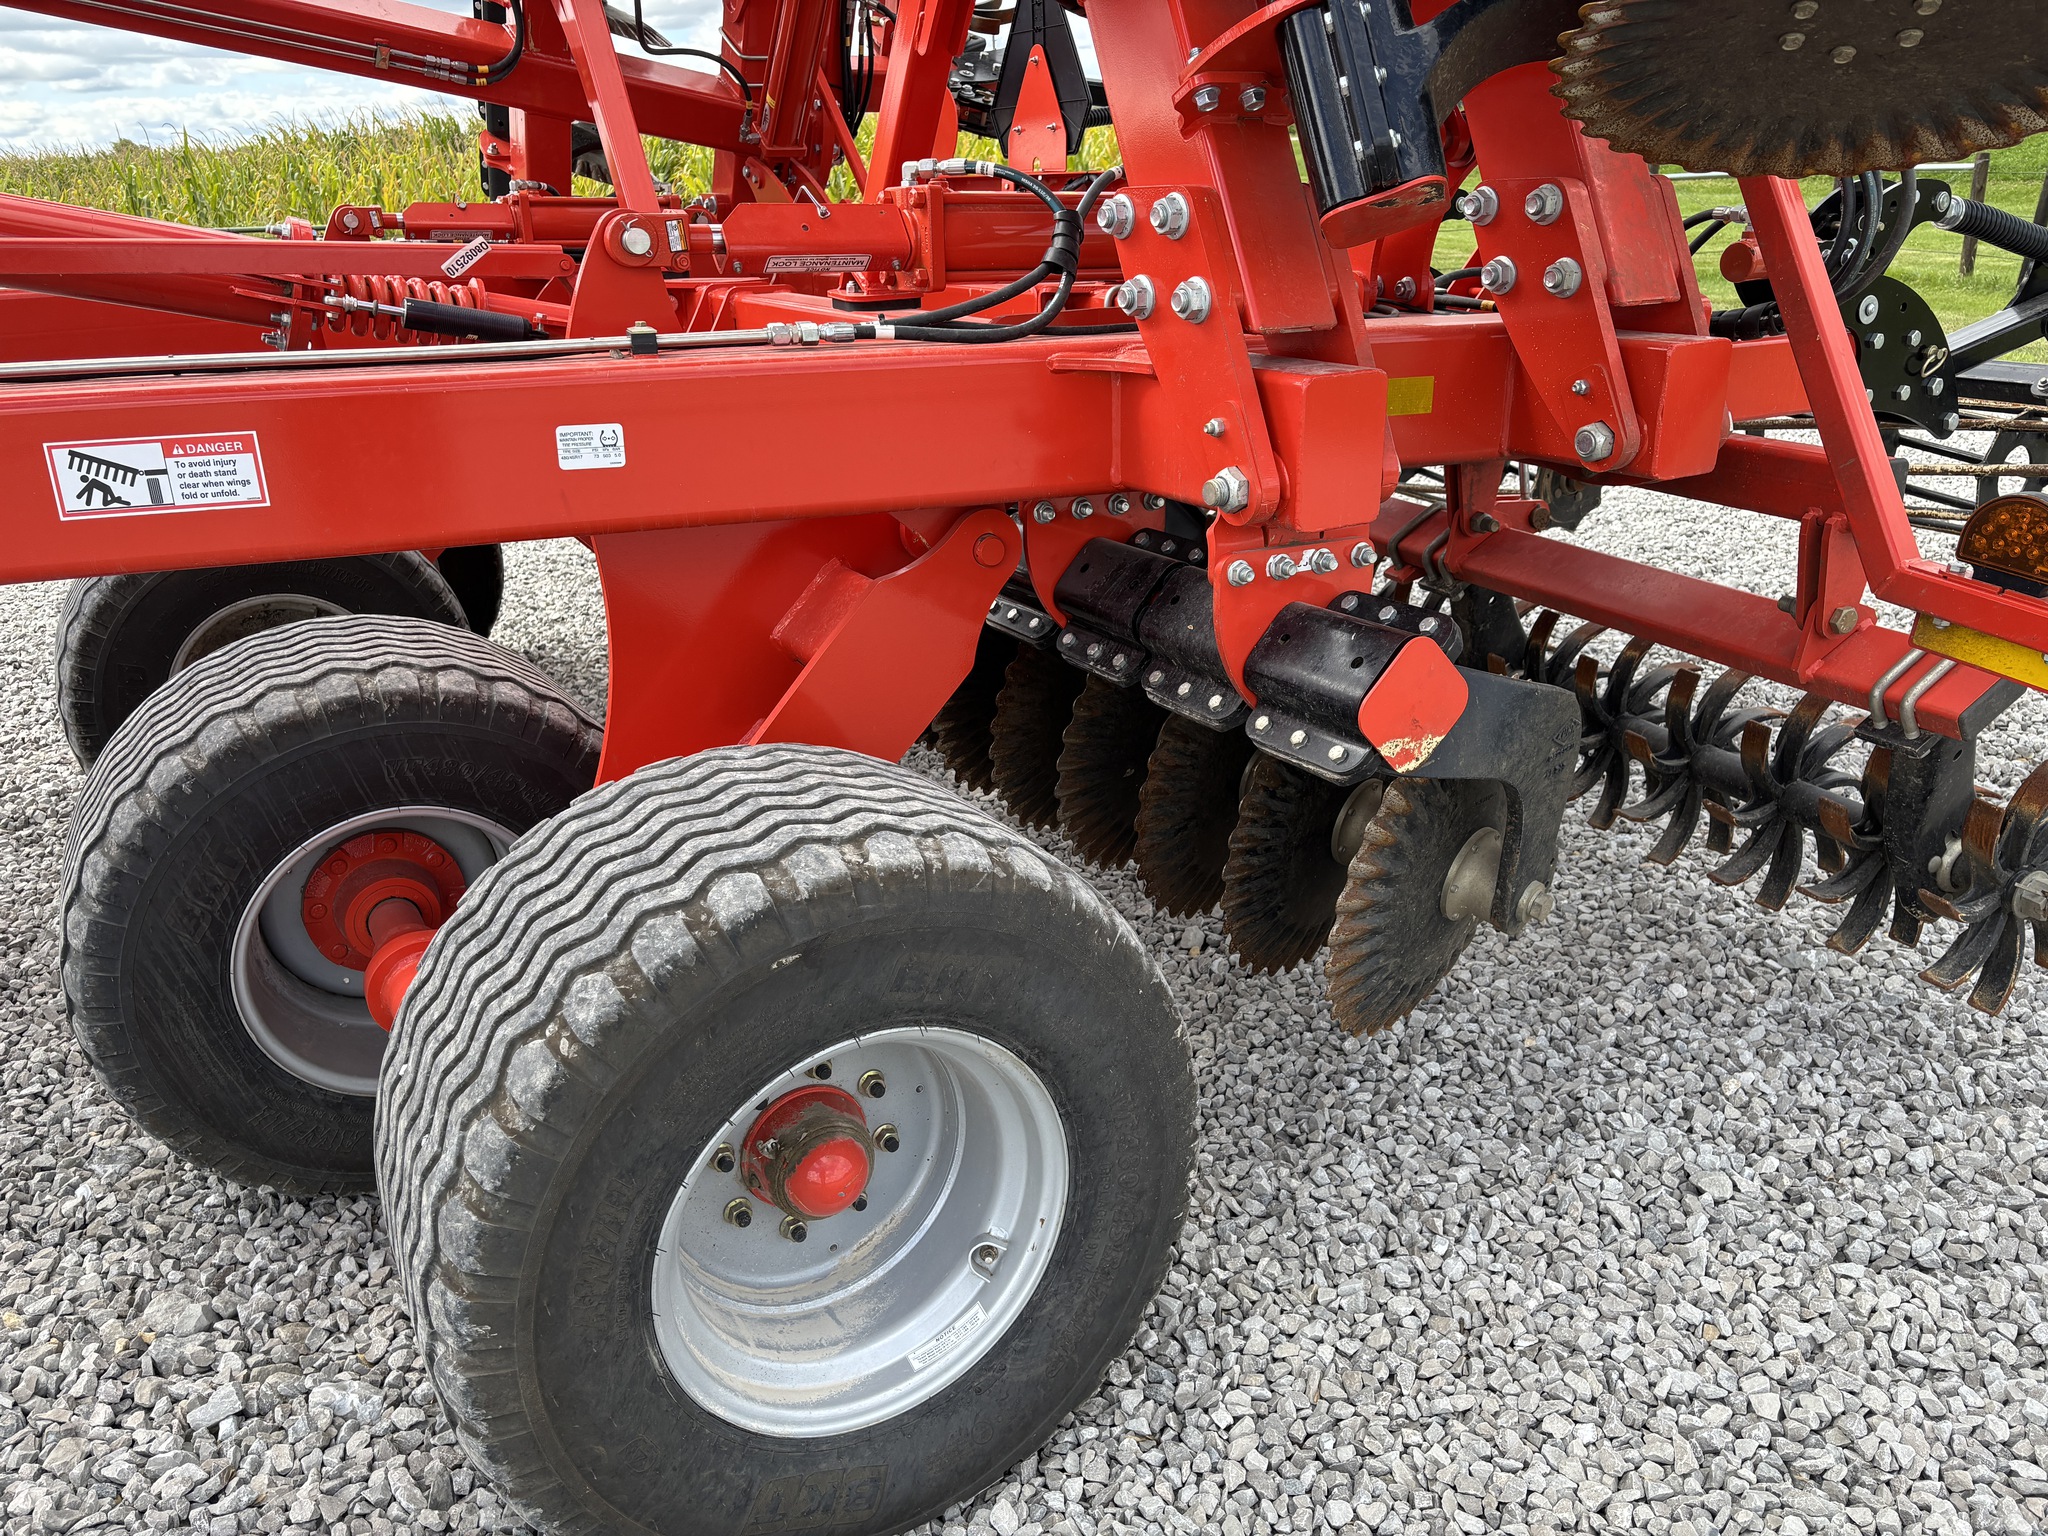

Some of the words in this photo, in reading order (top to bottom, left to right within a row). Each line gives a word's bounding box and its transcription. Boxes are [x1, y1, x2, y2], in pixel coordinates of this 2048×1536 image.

[446, 241, 489, 276] Q8092510
[800, 259, 865, 267] MAINTENANCE
[186, 441, 243, 454] DANGER
[174, 460, 186, 469] To
[188, 459, 211, 468] avoid
[213, 458, 237, 468] injury
[188, 470, 212, 478] death
[214, 468, 238, 476] stand
[179, 481, 200, 489] clear
[202, 479, 225, 488] when
[226, 478, 251, 488] wings
[181, 491, 198, 500] fold
[211, 489, 240, 498] unfold.
[935, 1324, 957, 1343] NOTICE
